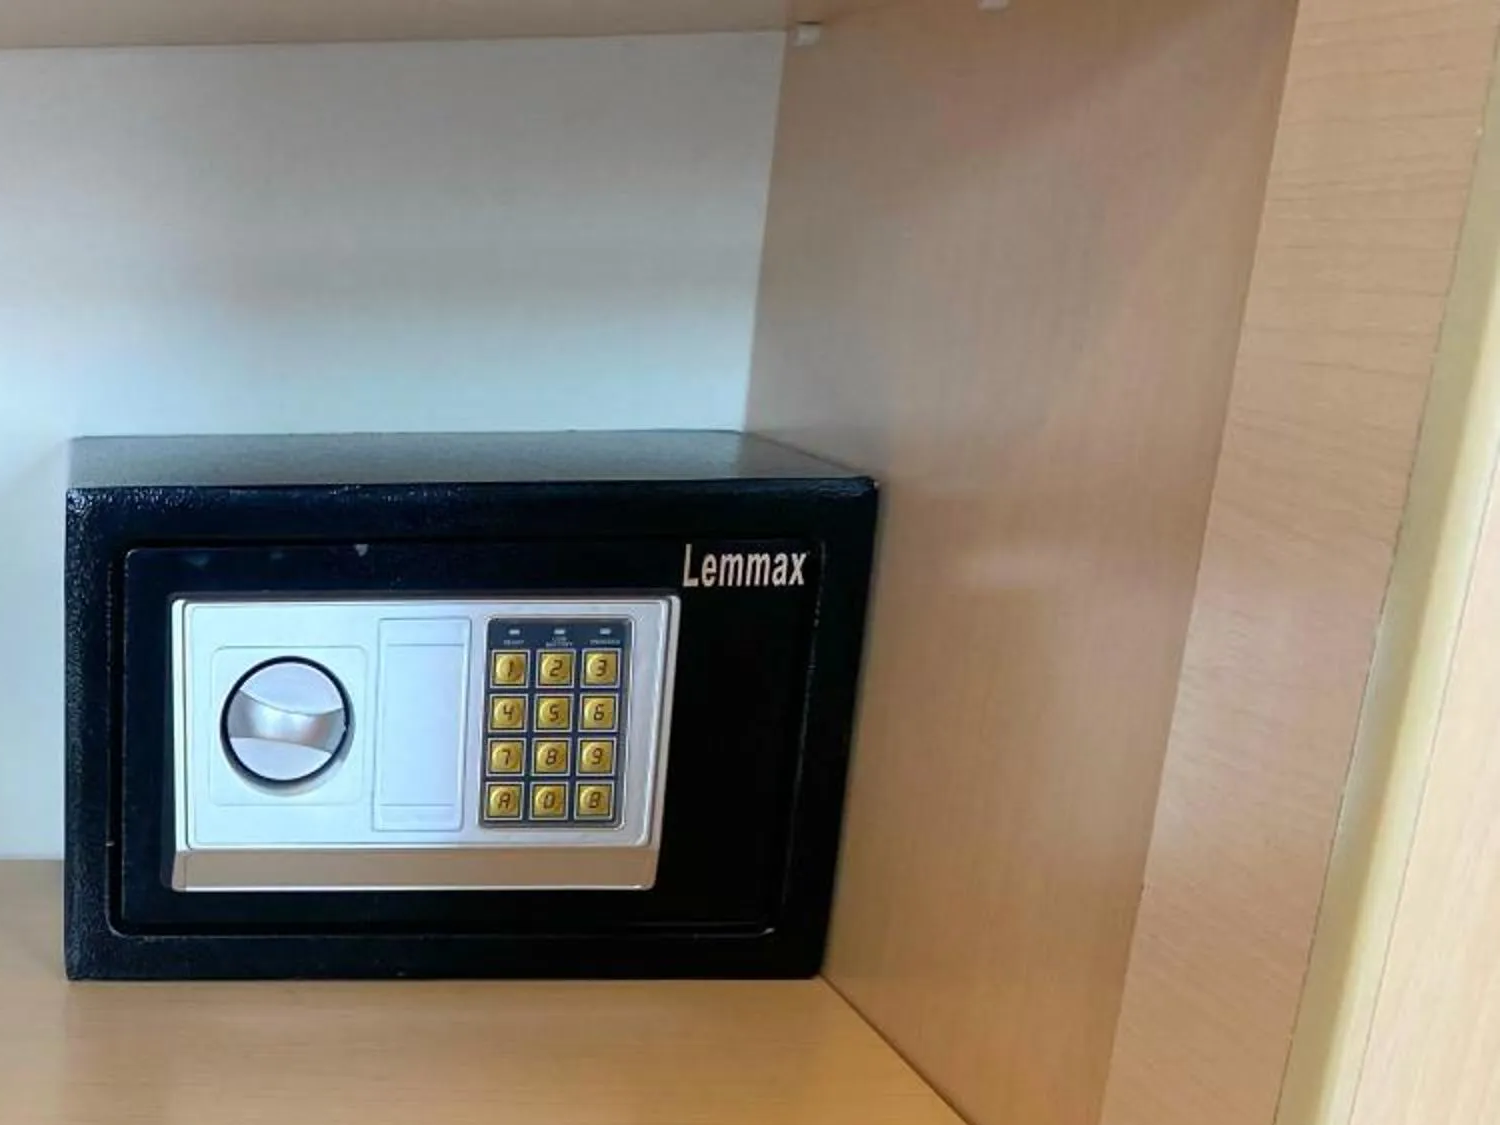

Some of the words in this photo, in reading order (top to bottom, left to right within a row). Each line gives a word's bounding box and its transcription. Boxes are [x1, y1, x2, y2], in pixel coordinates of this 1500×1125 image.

[682, 543, 808, 588] Lemmax
[507, 659, 515, 678] 1
[549, 659, 563, 677] 2
[595, 659, 607, 677] 3
[502, 704, 514, 721] 4
[549, 704, 560, 722] 5
[593, 704, 605, 721] 6
[501, 748, 512, 766] 7
[545, 748, 557, 765] 8
[591, 747, 603, 765] 9
